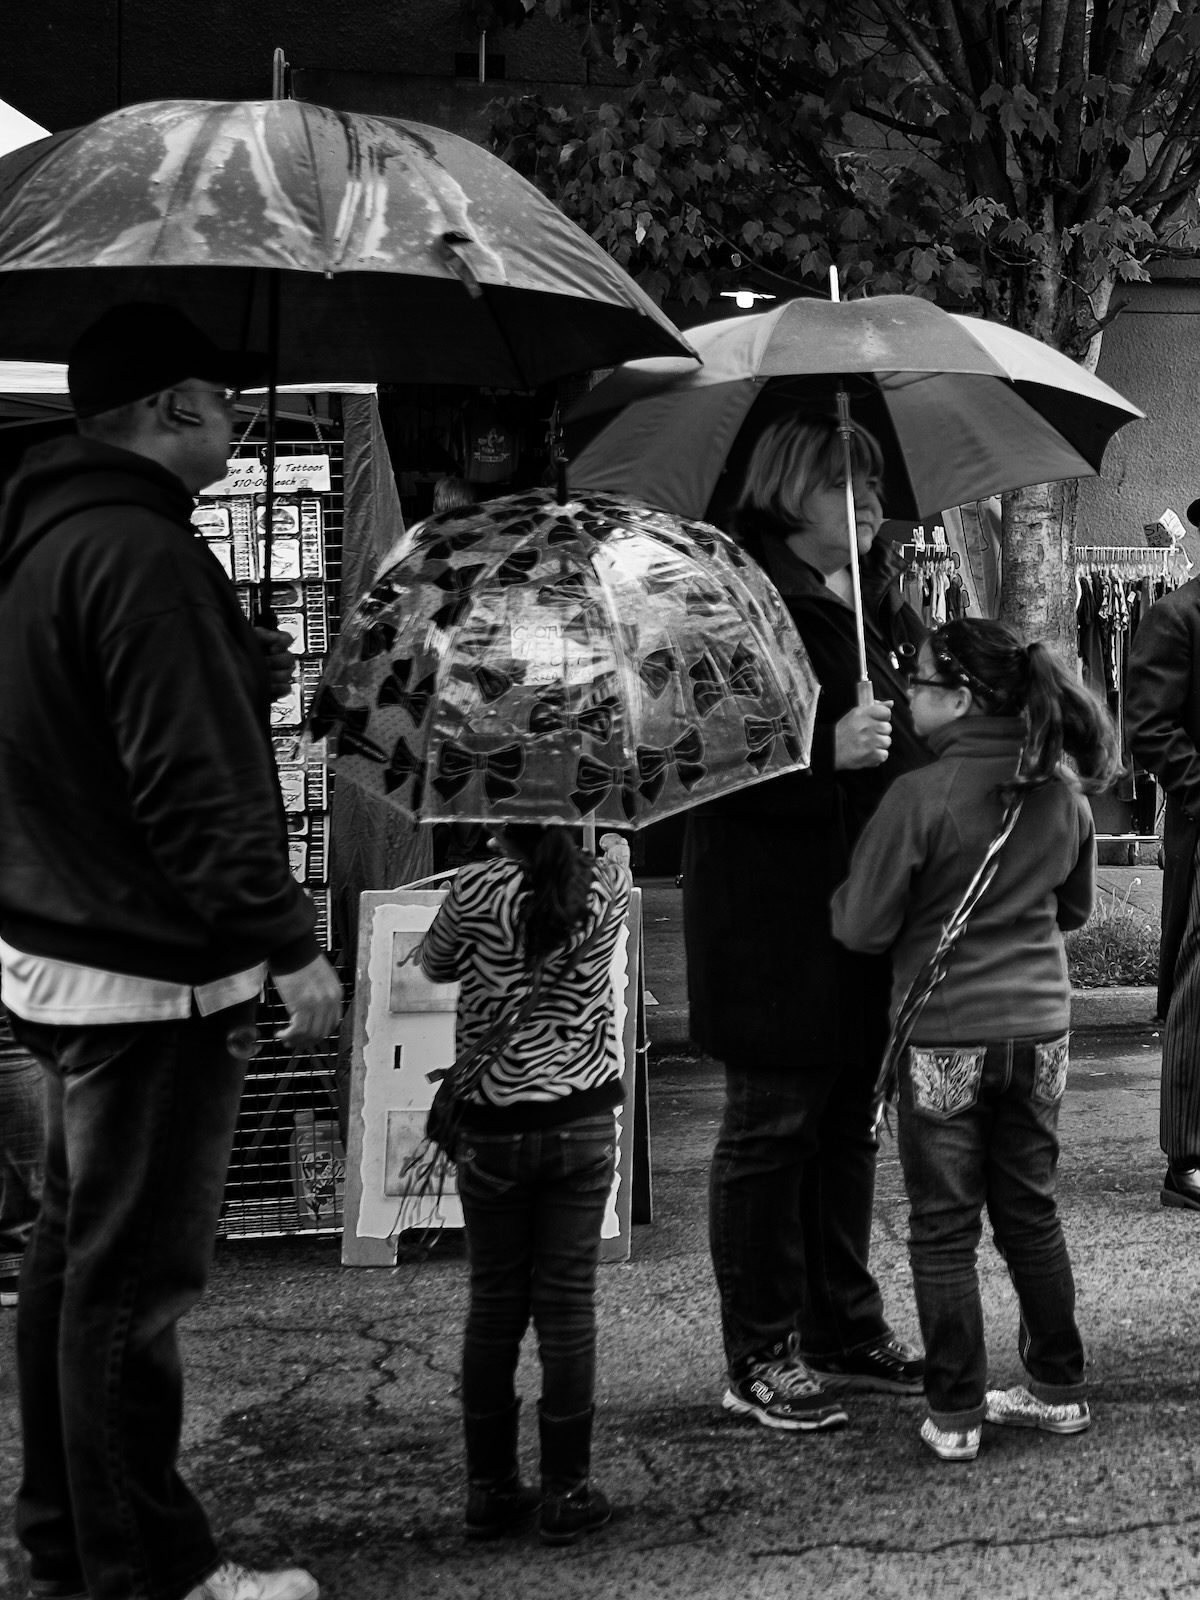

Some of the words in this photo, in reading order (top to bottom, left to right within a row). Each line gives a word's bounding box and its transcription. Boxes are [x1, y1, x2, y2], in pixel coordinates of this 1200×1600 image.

[259, 463, 281, 474] Nil
[285, 463, 324, 473] Tattoos
[274, 477, 297, 486] each
[750, 1379, 775, 1404] FILA
